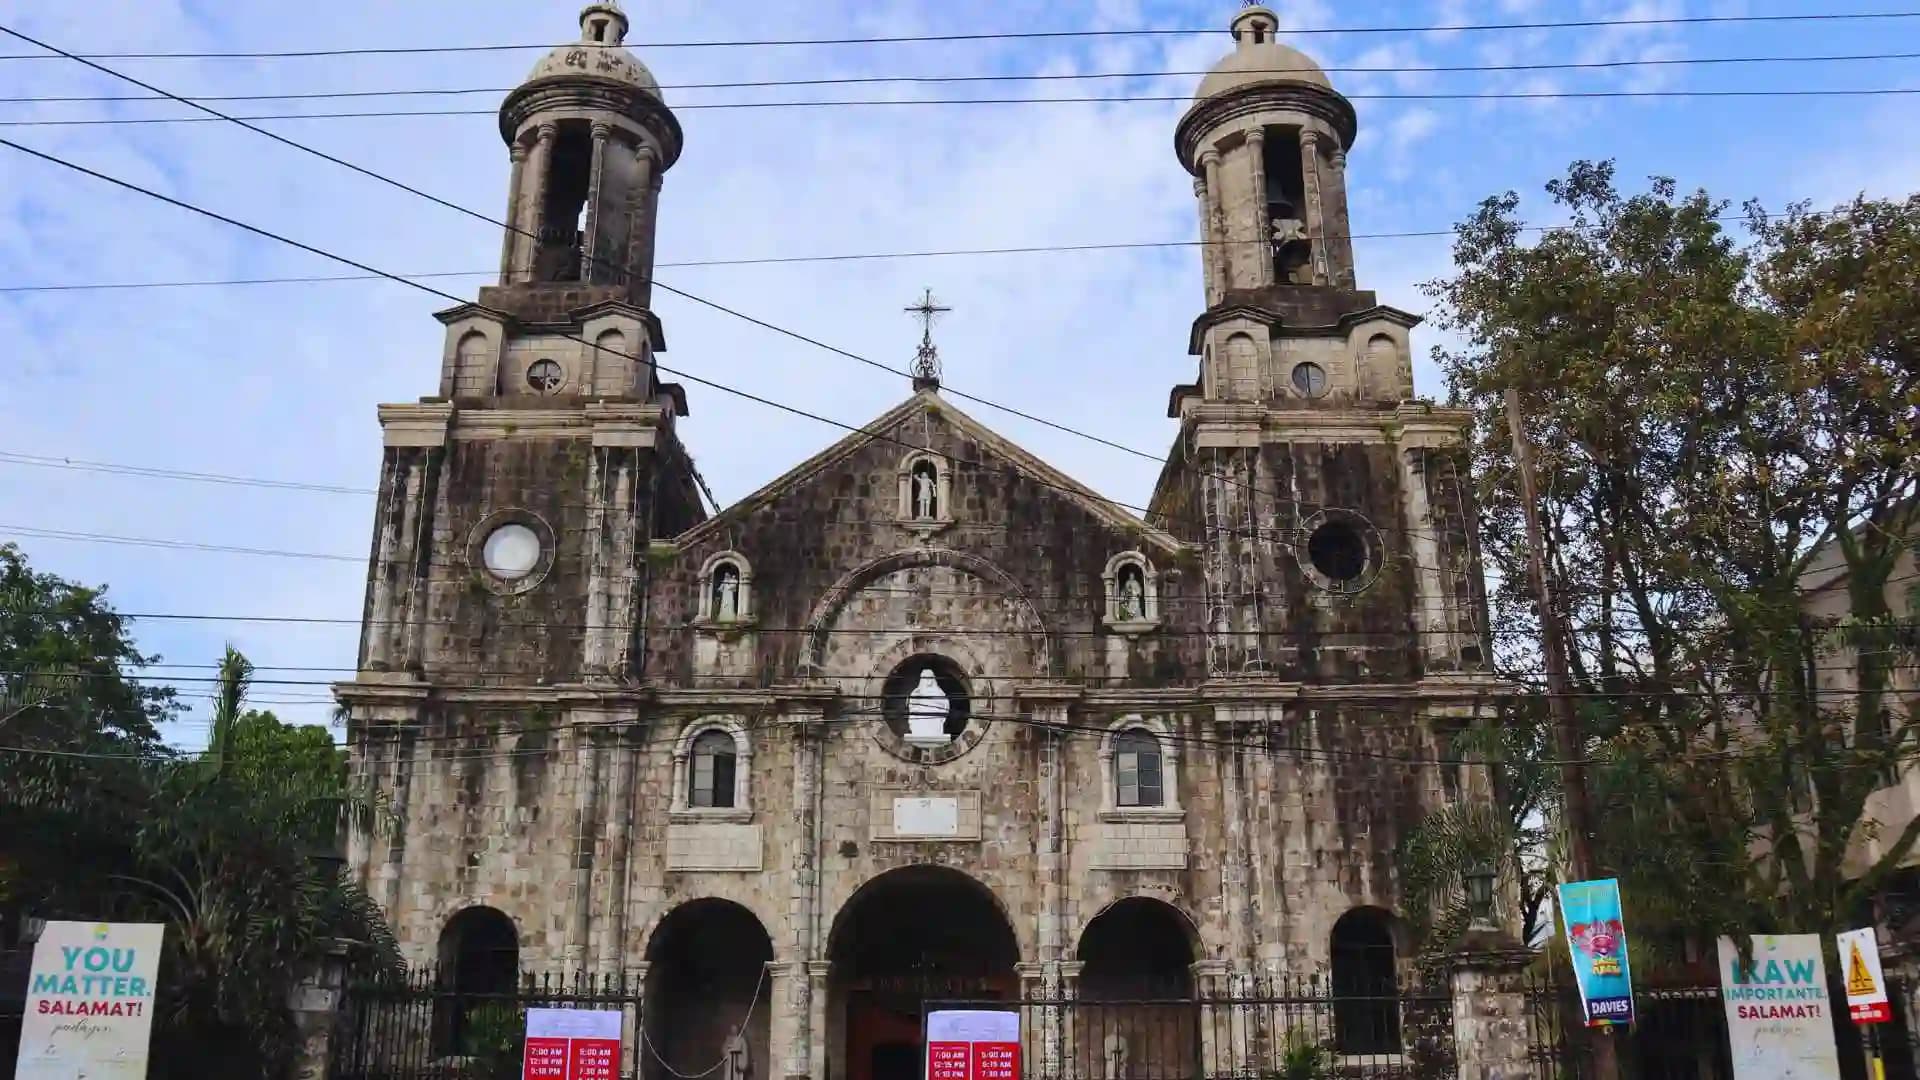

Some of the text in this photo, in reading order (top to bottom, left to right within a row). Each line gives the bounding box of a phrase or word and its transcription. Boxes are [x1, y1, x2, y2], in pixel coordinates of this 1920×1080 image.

[61, 945, 136, 973] YOU
[32, 974, 151, 997] MATTER.
[37, 999, 143, 1017] SALAMAT!
[1591, 1000, 1628, 1015] DAVIES
[1737, 1004, 1822, 1020] SALAMAT!
[550, 1048, 562, 1057] AM
[600, 1048, 611, 1056] AM
[598, 1058, 609, 1066] AM
[549, 1067, 561, 1075] PM
